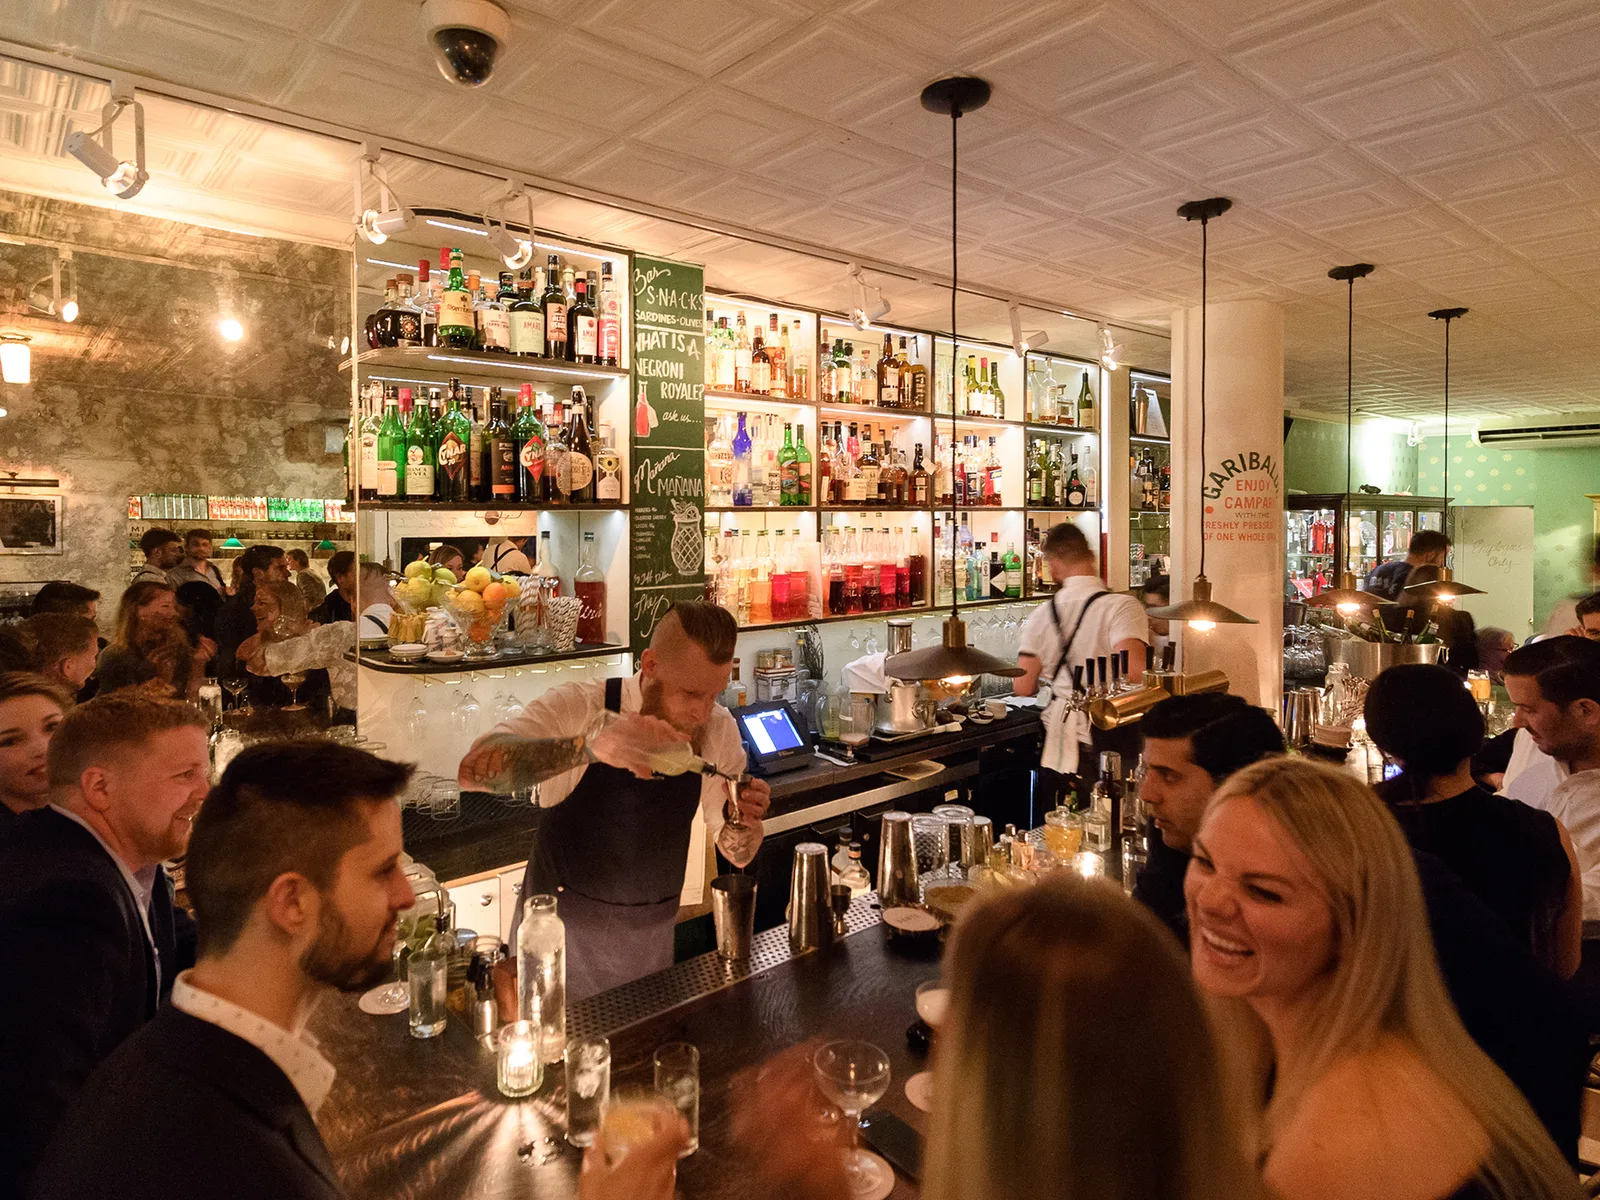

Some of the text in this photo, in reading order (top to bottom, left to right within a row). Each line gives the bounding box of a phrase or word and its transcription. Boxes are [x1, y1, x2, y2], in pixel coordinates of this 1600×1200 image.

[634, 309, 677, 324] SARDINES
[679, 316, 703, 328] OLIVES
[671, 332, 685, 352] IS
[686, 338, 702, 360] A
[634, 357, 684, 380] NEGRONI
[660, 381, 705, 401] ROYALE?
[438, 443, 467, 466] CYNAR
[657, 474, 704, 498] MAÑANA
[1235, 479, 1271, 492] ENJOY
[1224, 496, 1273, 509] CAMPAR
[1203, 521, 1273, 530] RESHLY PRESSE
[1216, 532, 1234, 541] ONE
[1237, 532, 1265, 541] WHOLE
[1487, 556, 1521, 574] Only
